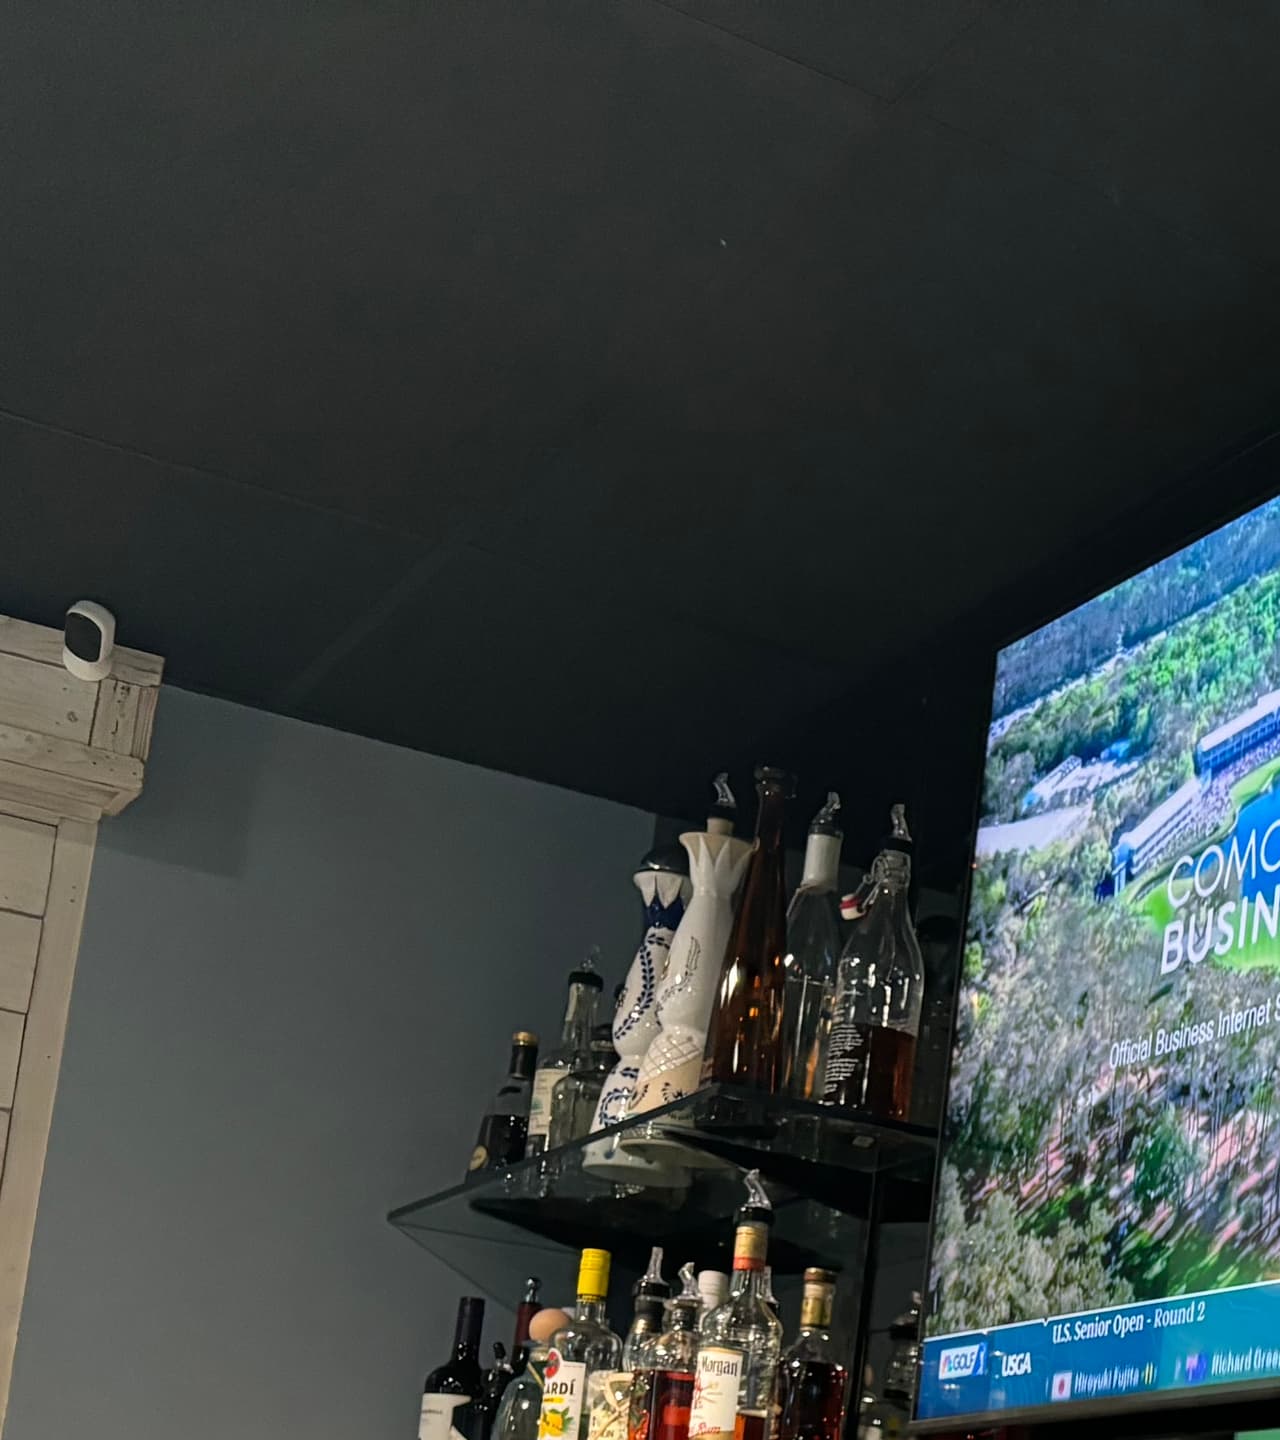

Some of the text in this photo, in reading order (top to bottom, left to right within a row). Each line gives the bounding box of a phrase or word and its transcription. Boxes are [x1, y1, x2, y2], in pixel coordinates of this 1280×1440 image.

[1110, 1040, 1152, 1069] Official
[1155, 1022, 1214, 1059] Business
[1218, 1003, 1270, 1039] Internet
[1075, 1303, 1196, 1340] Senior Open Round
[700, 1355, 738, 1377] Morgan
[1002, 1353, 1031, 1376] USGA
[543, 1379, 575, 1396] ARDÍ
